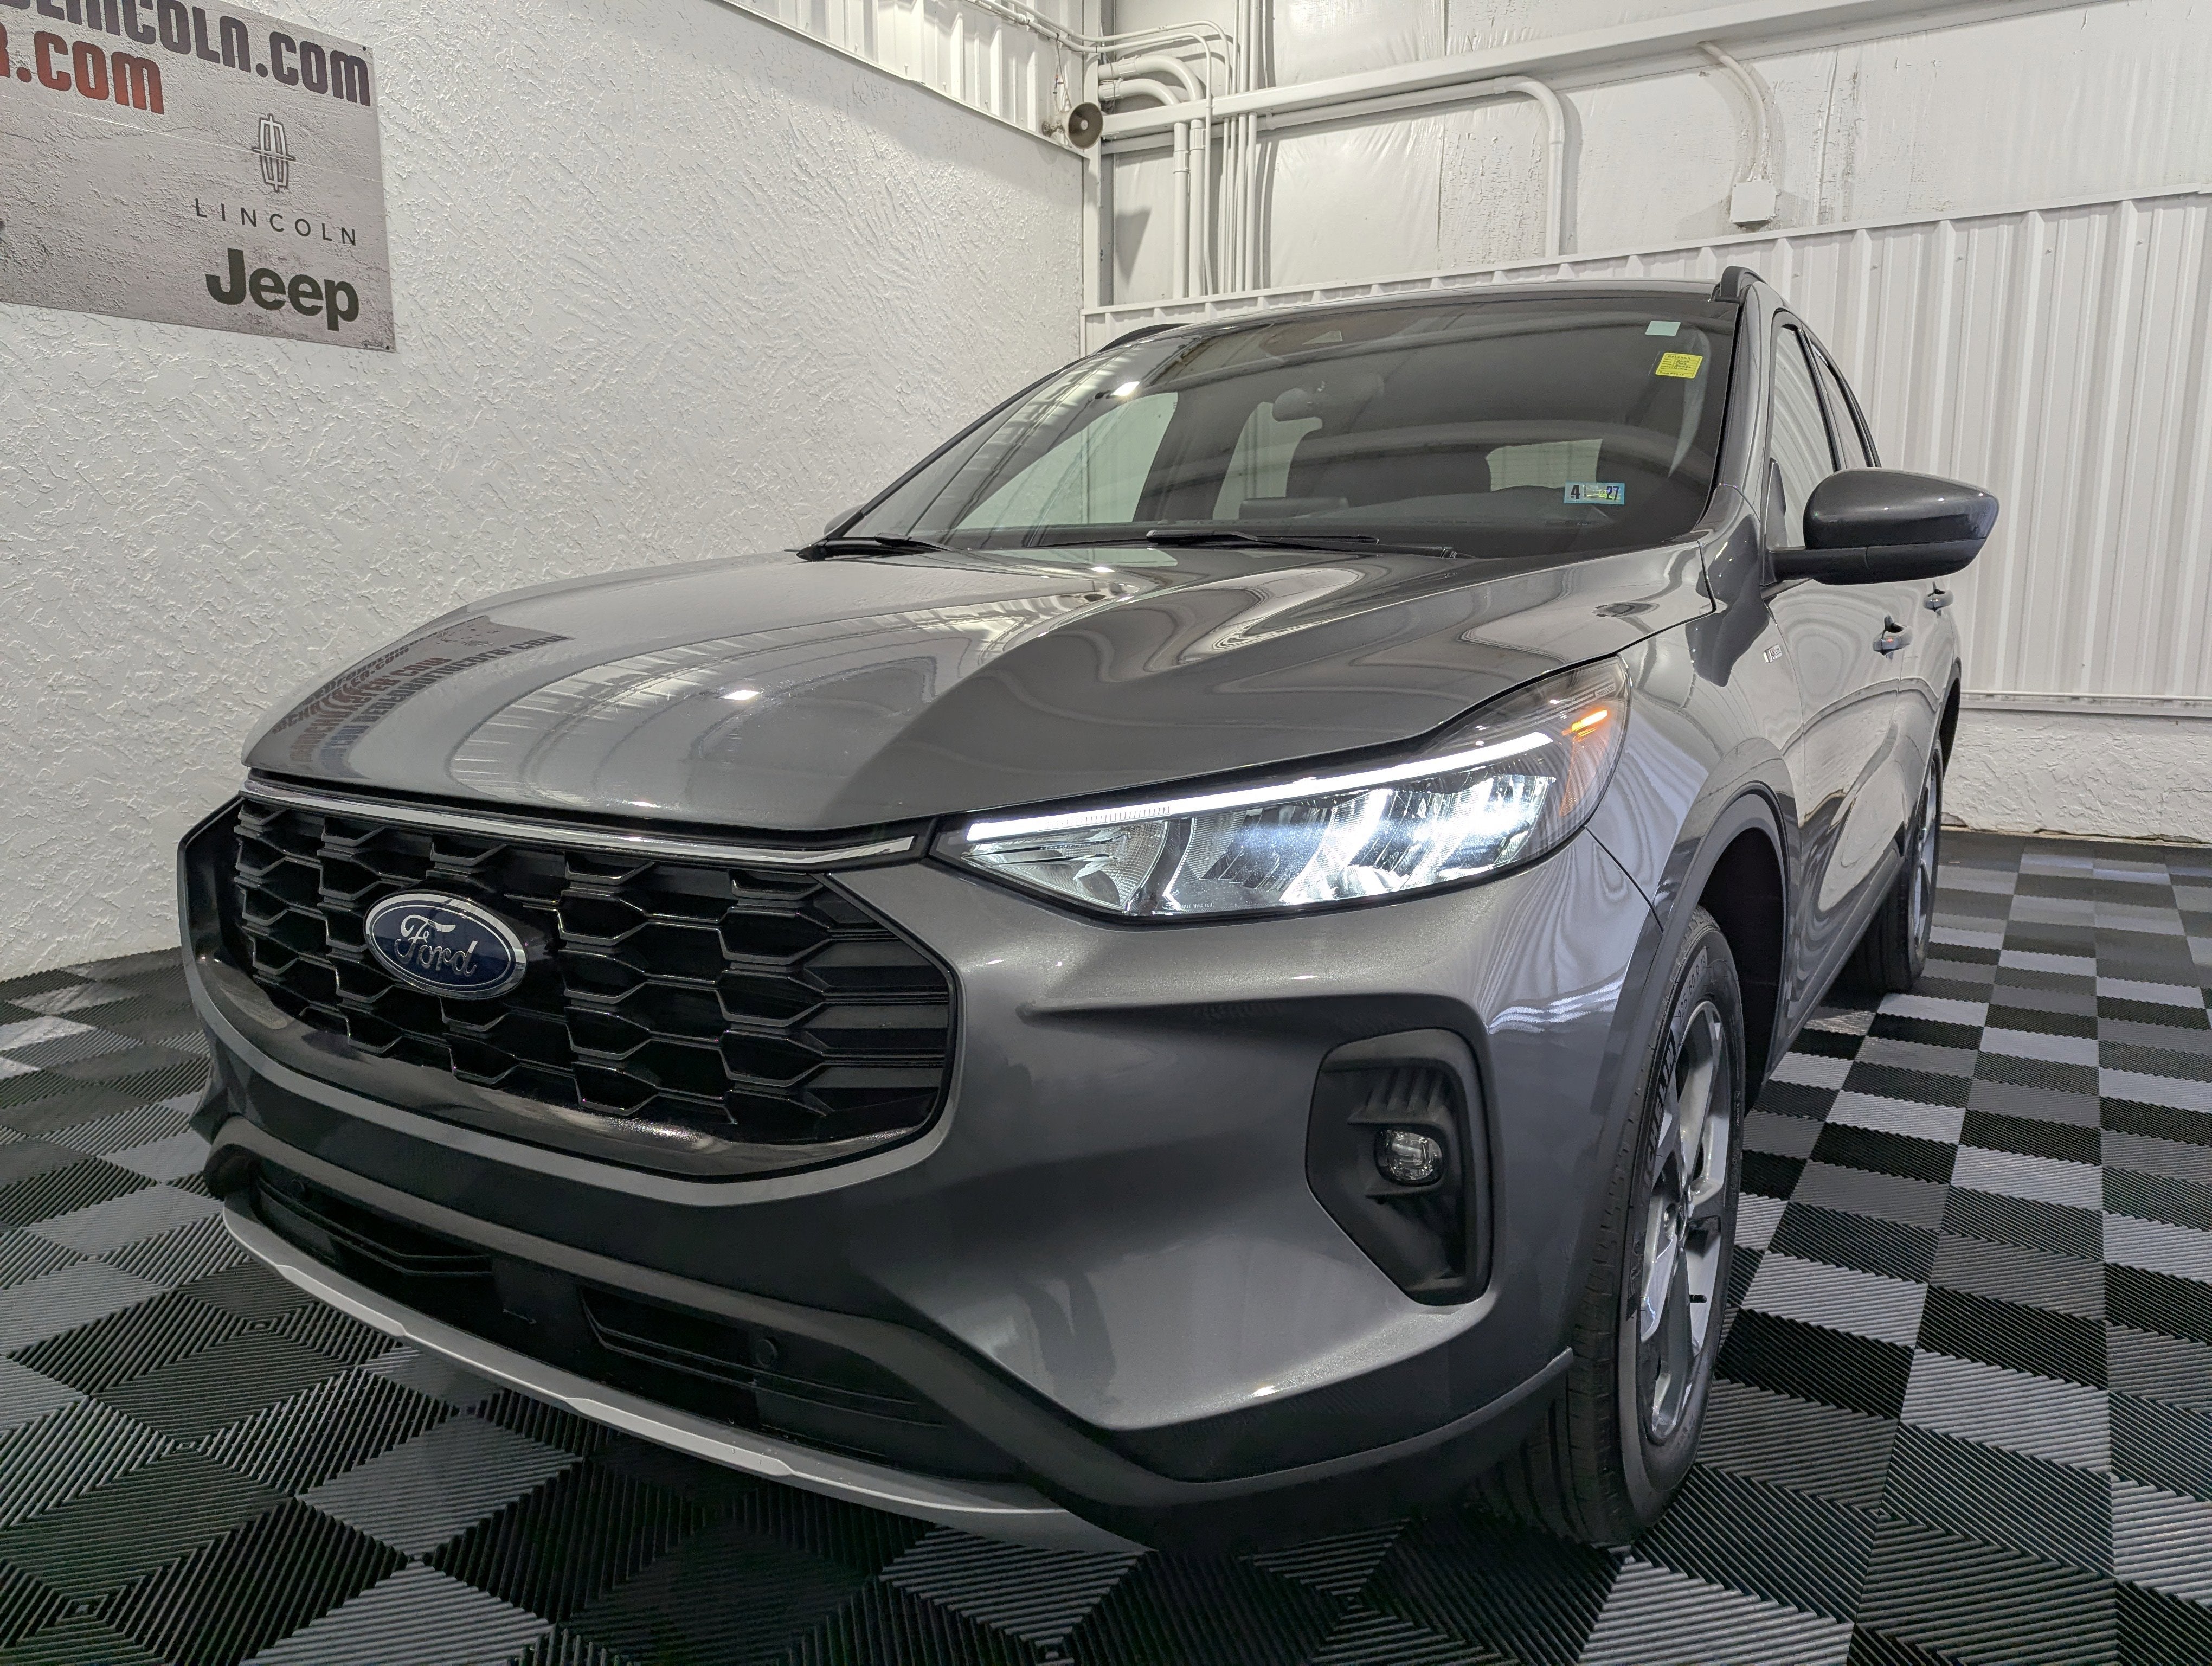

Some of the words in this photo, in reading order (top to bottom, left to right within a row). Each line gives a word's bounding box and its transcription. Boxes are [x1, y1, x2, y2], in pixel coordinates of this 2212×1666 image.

[195, 198, 356, 246] LINCOLN
[205, 248, 359, 332] Jeep
[1570, 484, 1580, 499] 4
[1606, 485, 1619, 500] 27
[394, 914, 478, 976] Ford
